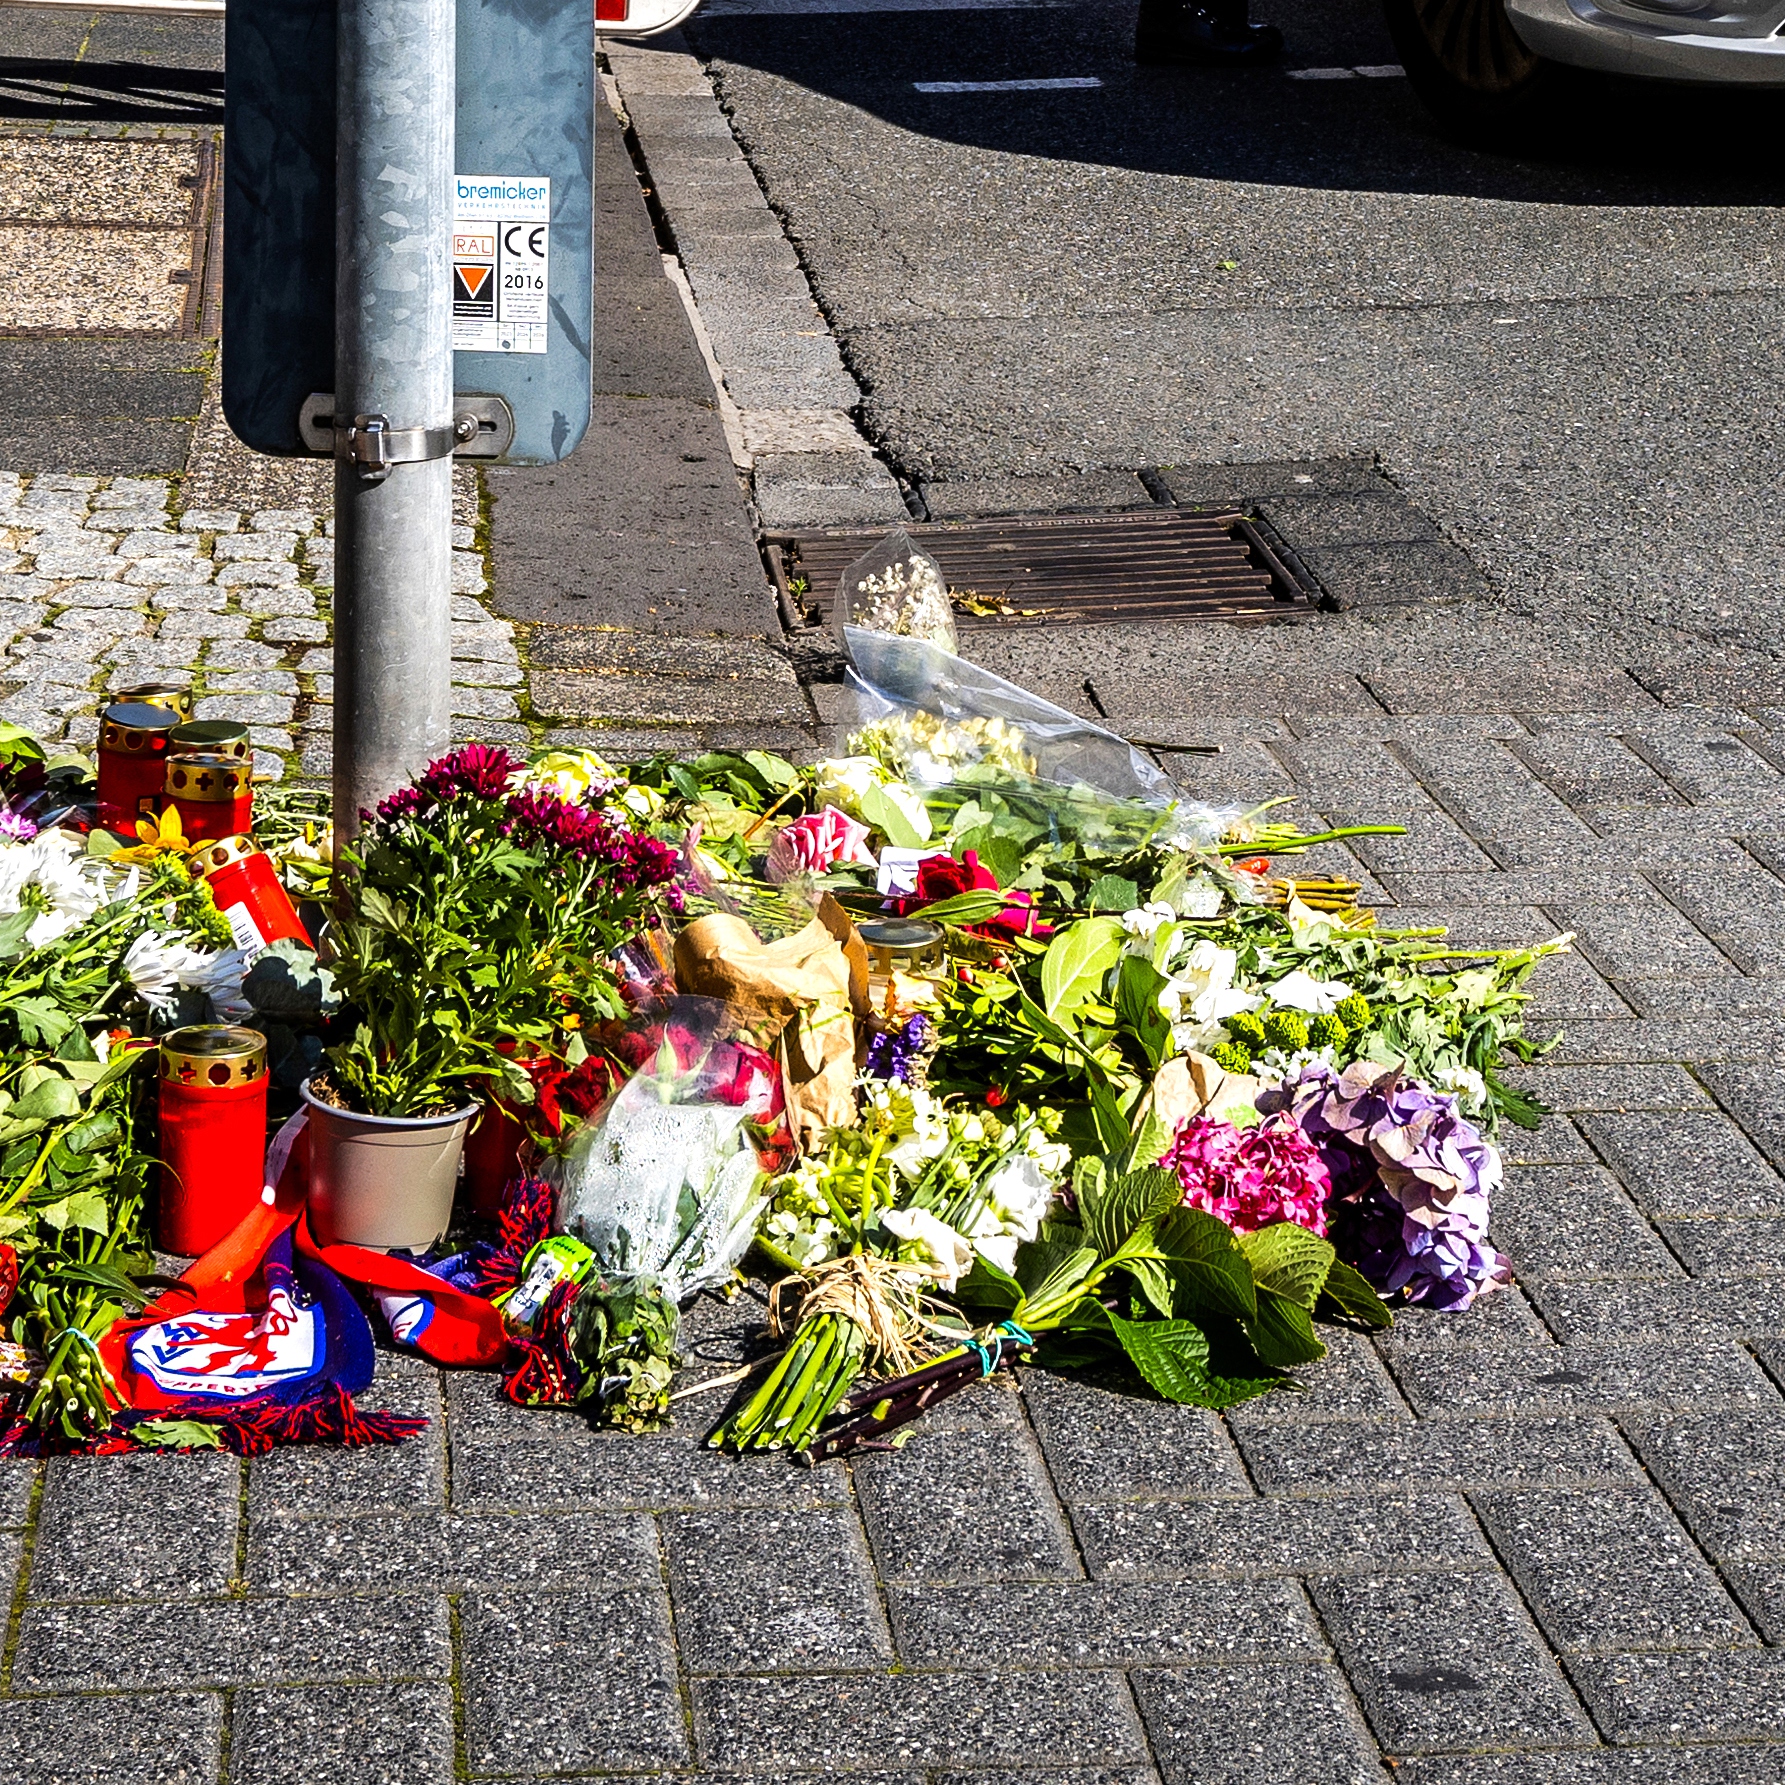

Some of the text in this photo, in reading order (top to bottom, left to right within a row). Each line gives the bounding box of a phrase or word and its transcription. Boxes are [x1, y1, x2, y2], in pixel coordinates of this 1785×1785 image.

[457, 179, 546, 200] bremicker
[457, 238, 491, 254] RAL
[504, 225, 545, 258] CE
[504, 274, 544, 290] 2016
